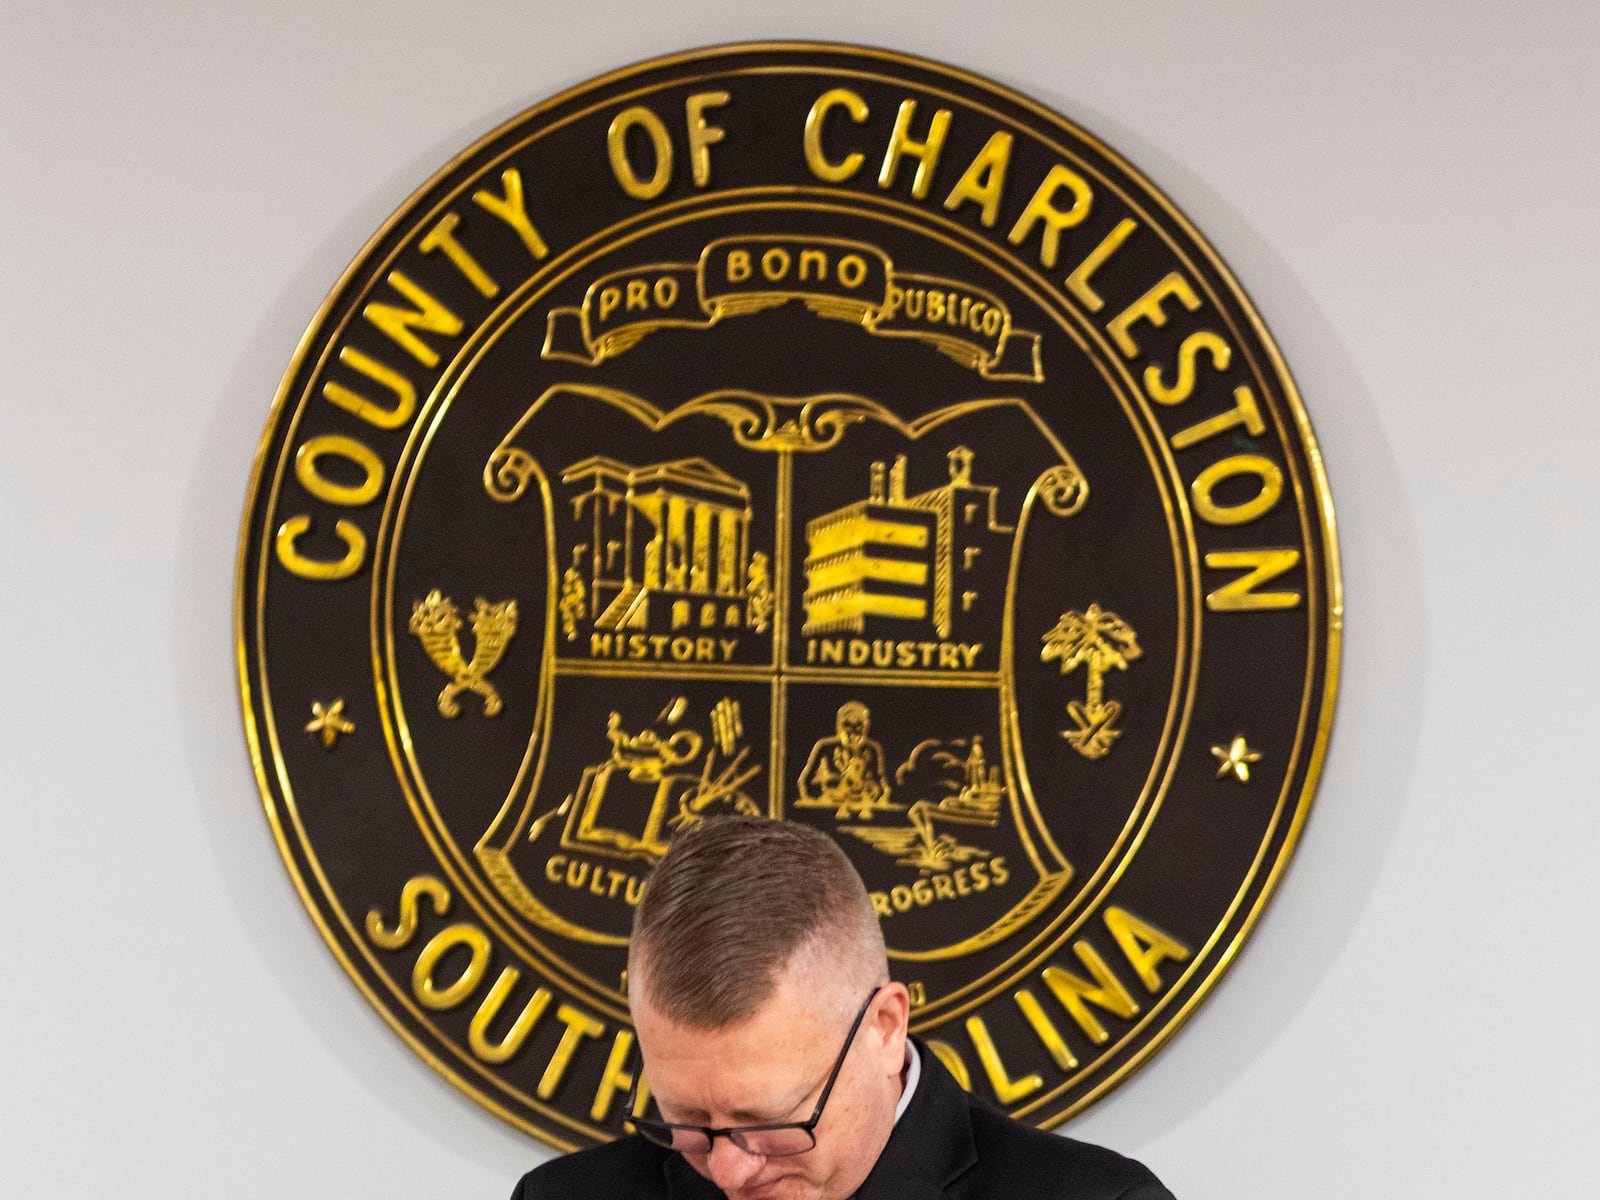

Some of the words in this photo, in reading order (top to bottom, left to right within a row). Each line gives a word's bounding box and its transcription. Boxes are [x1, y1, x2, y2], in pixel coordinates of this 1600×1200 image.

[600, 277, 679, 321] PRO
[889, 285, 1000, 337] PUBLICO
[276, 168, 549, 580] COUNTY
[606, 92, 730, 200] OF
[804, 89, 1300, 611] CHARLESTON
[590, 632, 739, 662] HISTORY
[807, 638, 982, 669] INDUSTRY
[545, 855, 648, 905] CULTU
[869, 857, 1010, 917] ROGRESS
[926, 905, 1192, 1105] LINA
